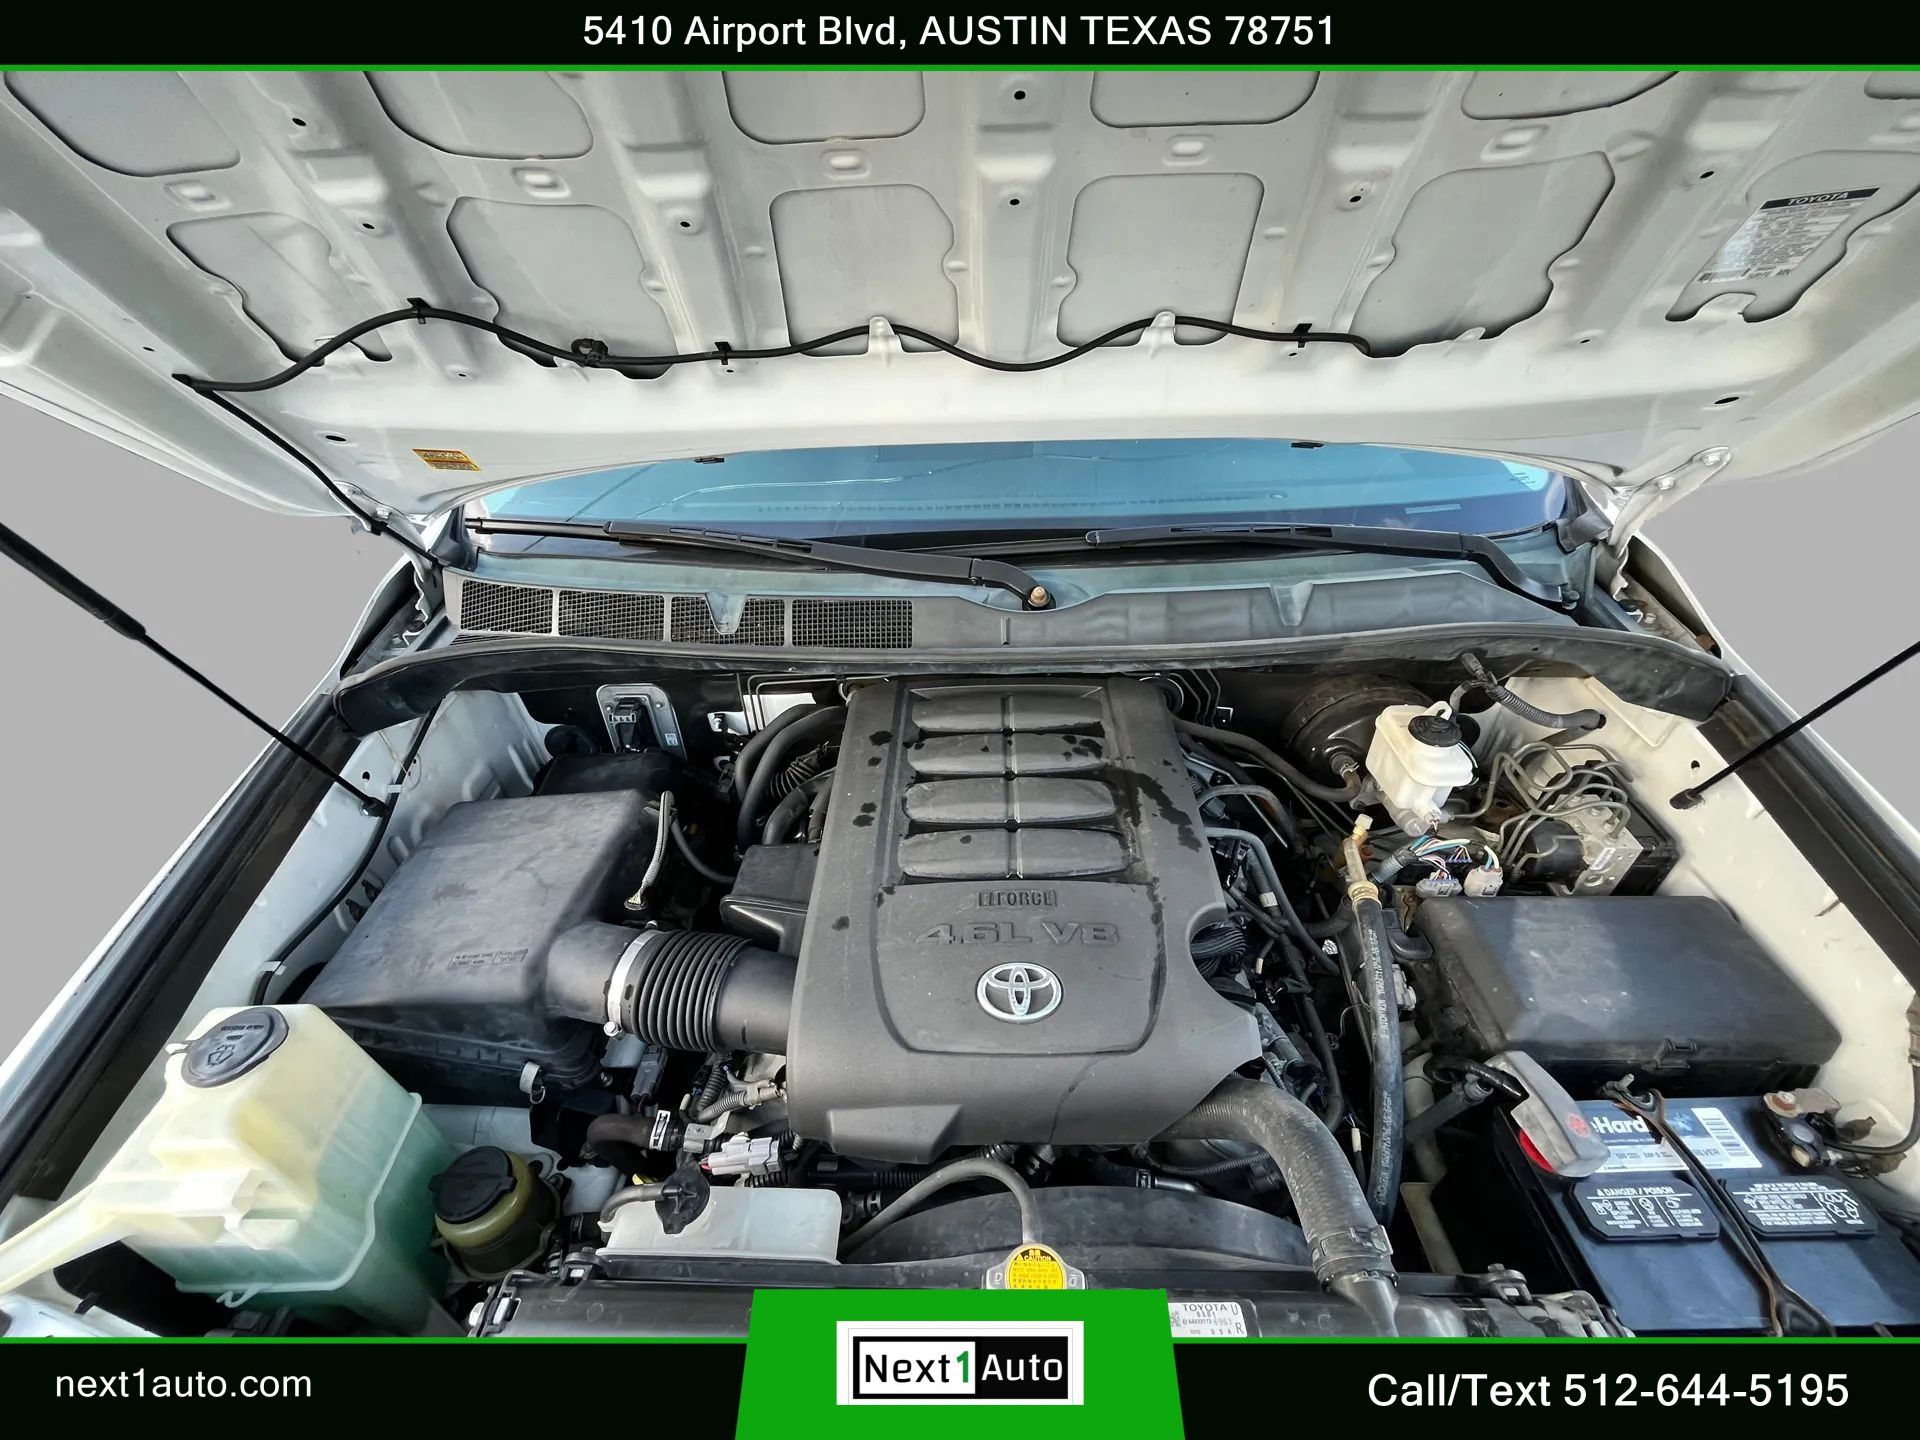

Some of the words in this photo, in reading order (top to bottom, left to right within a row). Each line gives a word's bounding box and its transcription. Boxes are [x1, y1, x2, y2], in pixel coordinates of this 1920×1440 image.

[1787, 192, 1849, 206] TOYOTA
[916, 921, 1032, 945] 4.6L
[1042, 921, 1120, 945] V8
[1603, 1187, 1638, 1196] DANGER
[1644, 1186, 1675, 1195] POISON
[1182, 1303, 1228, 1312] TOYOTA
[1235, 1322, 1244, 1334] R
